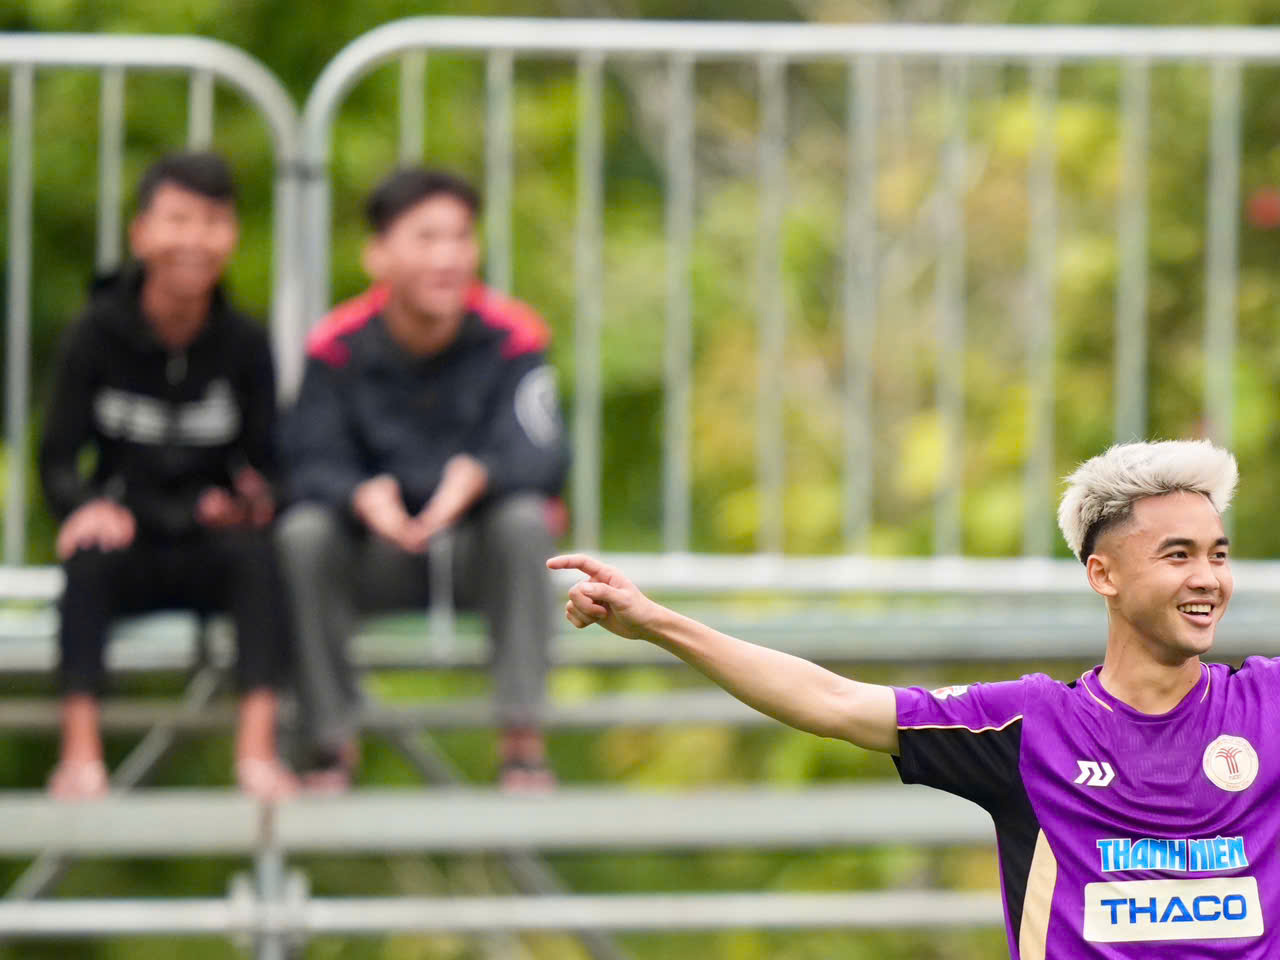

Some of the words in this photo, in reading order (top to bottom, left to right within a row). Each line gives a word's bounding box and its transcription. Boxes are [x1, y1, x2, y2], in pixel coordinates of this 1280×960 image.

[1096, 838, 1187, 872] THANH
[1188, 835, 1249, 872] NIÊN
[1100, 894, 1247, 925] THACO
